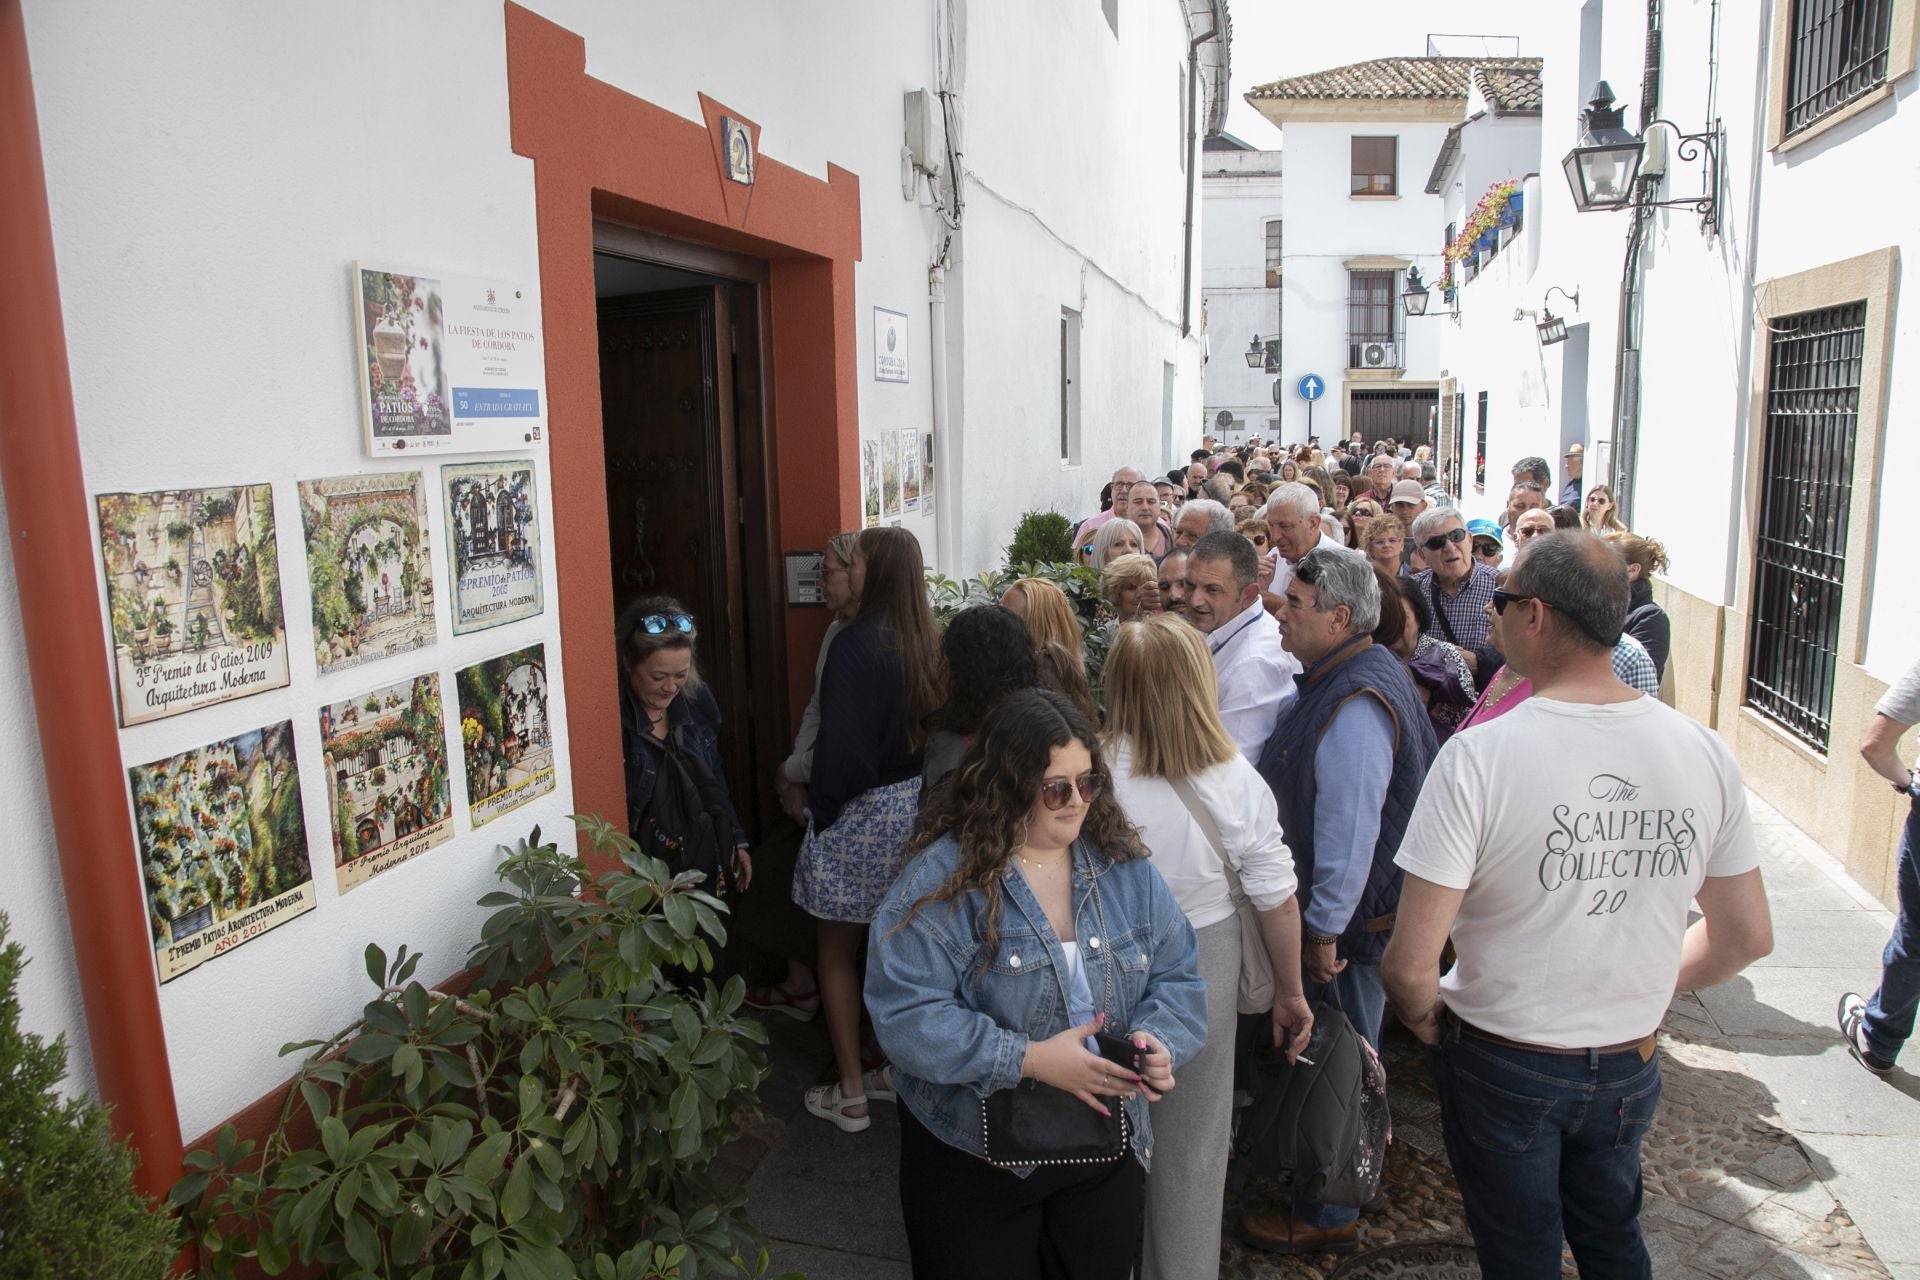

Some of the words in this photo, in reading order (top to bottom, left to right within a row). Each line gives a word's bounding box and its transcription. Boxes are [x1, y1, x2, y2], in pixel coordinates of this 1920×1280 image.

[733, 136, 747, 175] 2
[448, 325, 459, 335] LA
[459, 325, 485, 337] FIESTA
[486, 328, 497, 338] DE
[497, 329, 511, 339] LOS
[512, 330, 535, 342] PATIOS
[472, 339, 482, 349] DE
[380, 402, 413, 413] PATIOS
[153, 661, 192, 684] Premio
[195, 657, 208, 674] de
[211, 651, 244, 672] Patios
[247, 641, 273, 663] 2009
[146, 680, 217, 711] Arquitectura
[220, 669, 266, 690] Moderna
[1588, 773, 1641, 802] The
[360, 849, 390, 867] Premio
[410, 841, 430, 857] 2012
[1586, 889, 1628, 917] 2.0
[213, 934, 239, 955] AÑO
[243, 921, 268, 939] 2011
